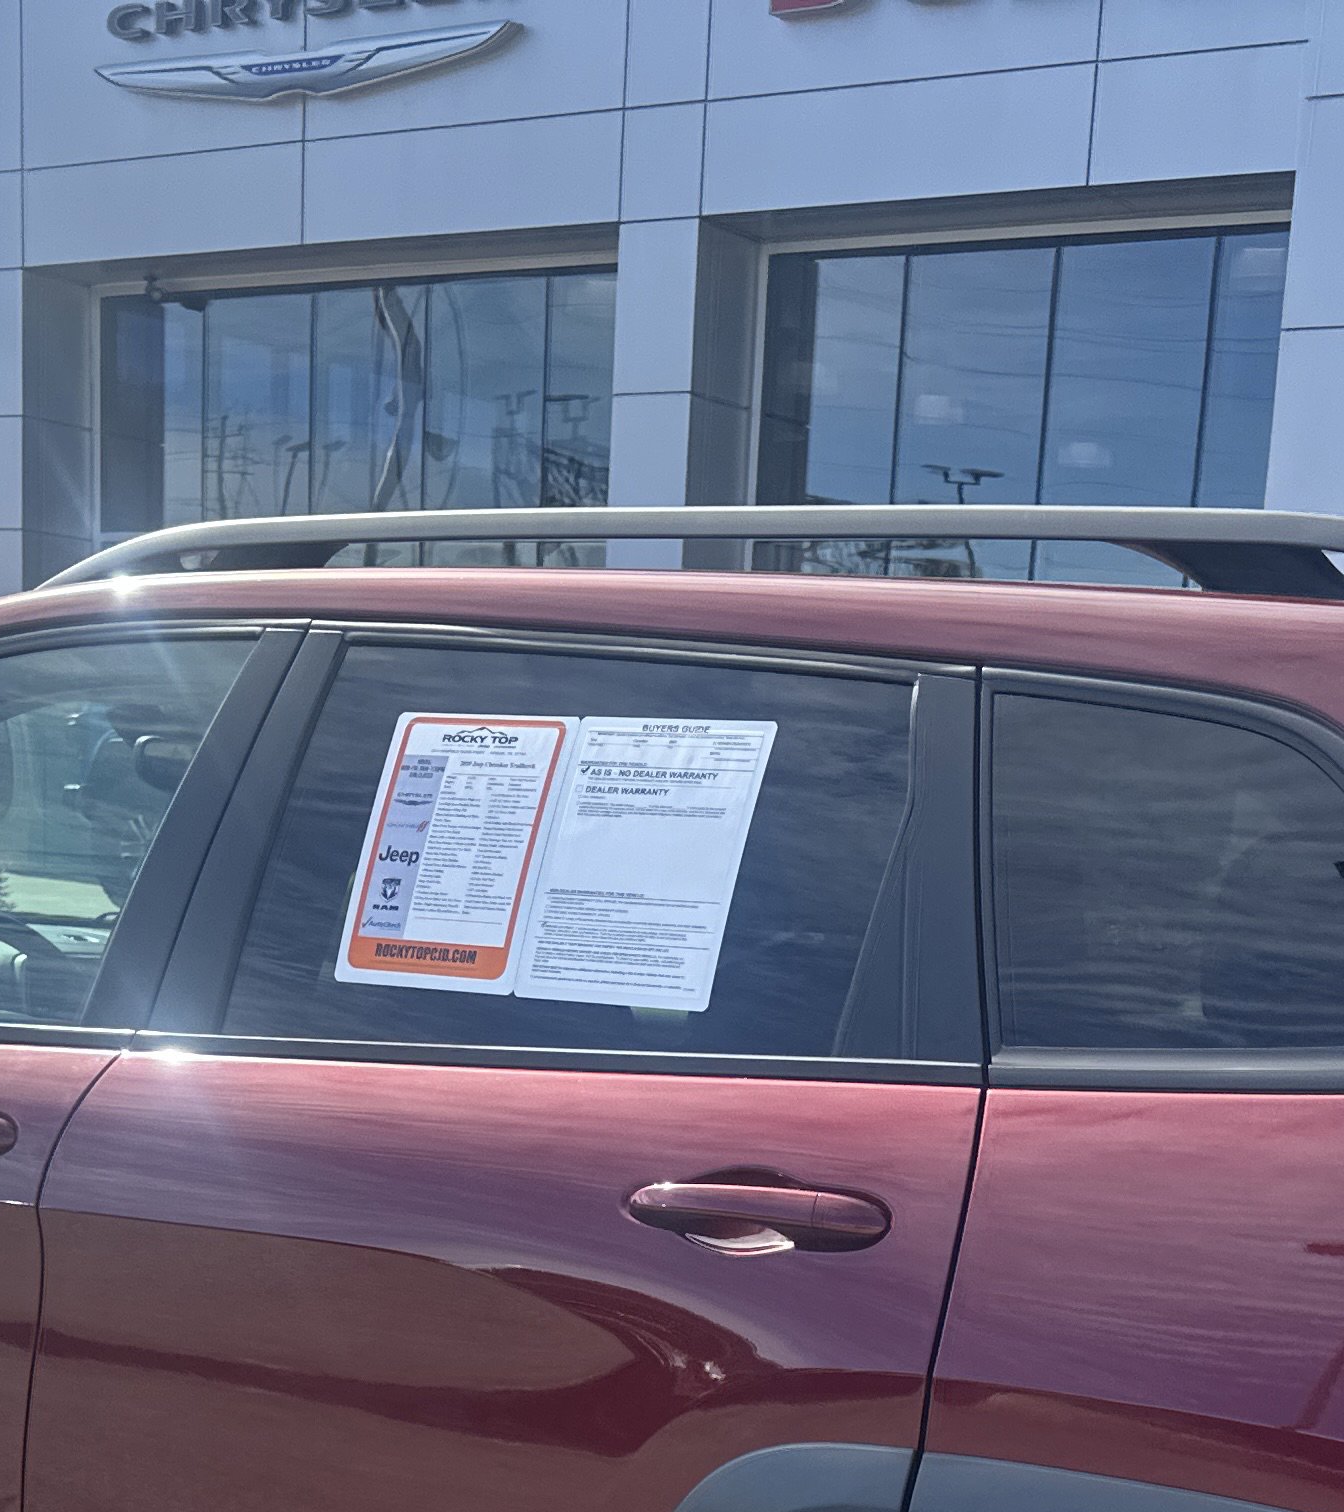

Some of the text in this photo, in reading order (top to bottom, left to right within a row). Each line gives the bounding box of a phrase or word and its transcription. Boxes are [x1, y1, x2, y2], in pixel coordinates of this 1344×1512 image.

[251, 58, 331, 74] CHRYSLER
[642, 724, 711, 734] BUYERS GUIDE
[442, 734, 519, 745] ROCKY TOP
[590, 768, 602, 776] AS
[603, 768, 612, 776] IS
[618, 769, 632, 778] NO
[633, 769, 667, 779] DEALER
[668, 770, 719, 781] WARRANTY
[585, 785, 670, 796] DEALER WARRANTY
[379, 845, 420, 867] Jeep
[375, 943, 478, 964] ROCKYTOPCJD.COM
